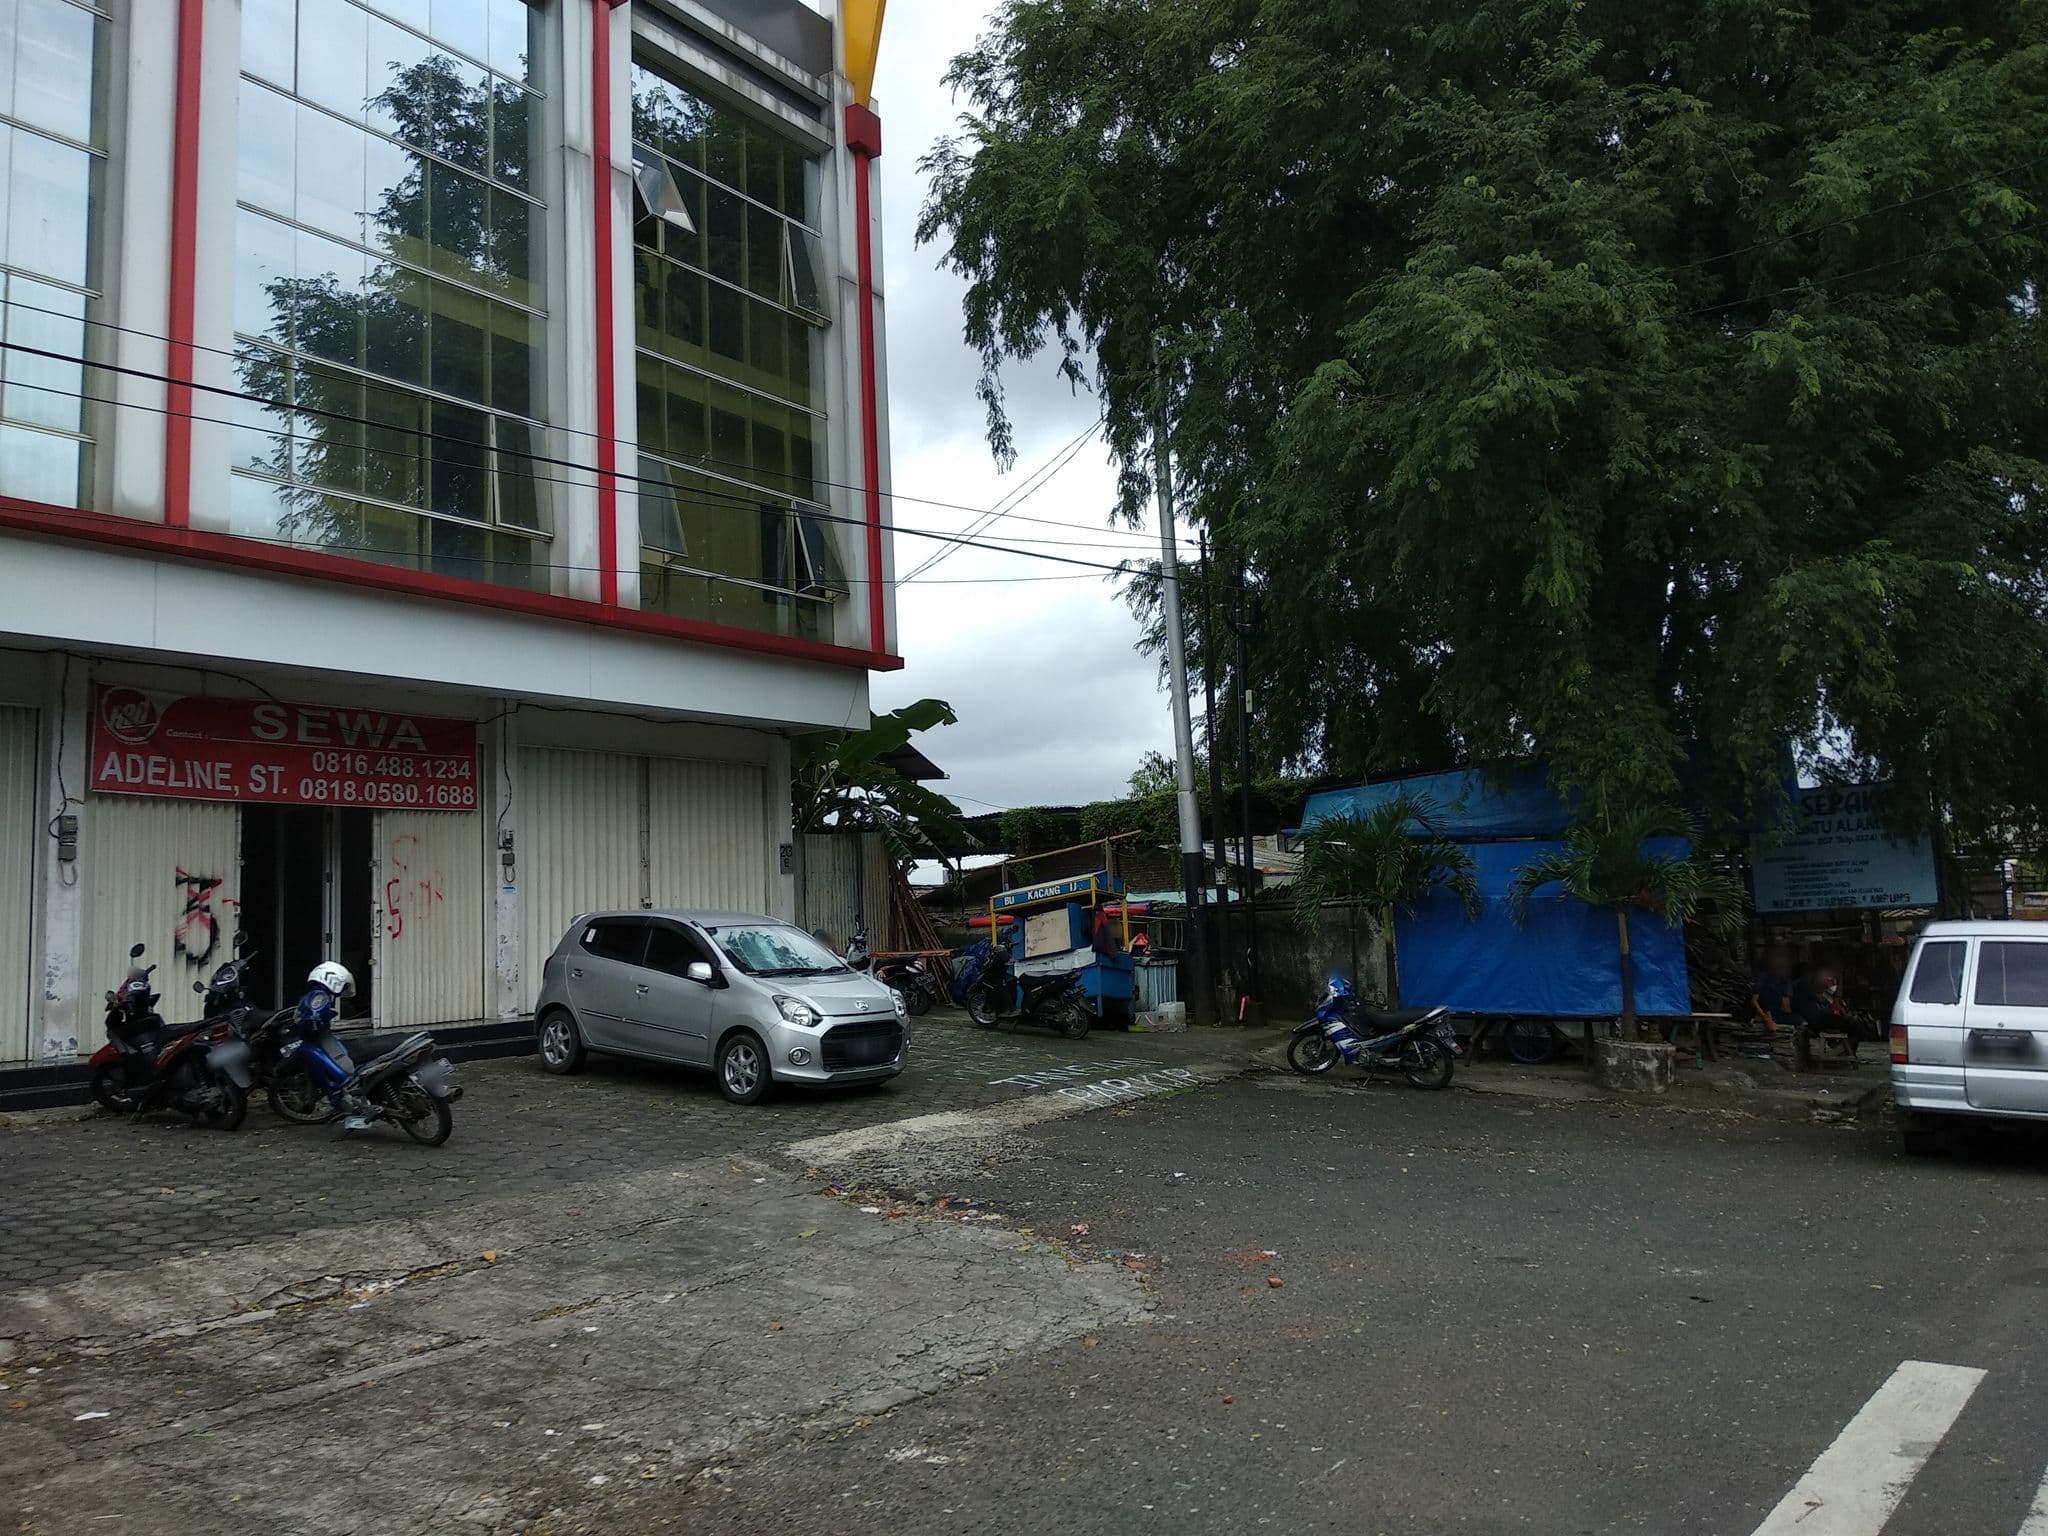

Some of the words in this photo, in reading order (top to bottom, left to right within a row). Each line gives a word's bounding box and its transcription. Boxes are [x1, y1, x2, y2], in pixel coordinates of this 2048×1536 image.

[250, 704, 427, 751] SEWA
[248, 764, 288, 795] ST.
[312, 751, 471, 780] 0816.488.1234
[299, 778, 475, 806] 0818.0580.1688
[1027, 886, 1061, 901] KACANG
[1056, 1066, 1200, 1108] PARKIR
